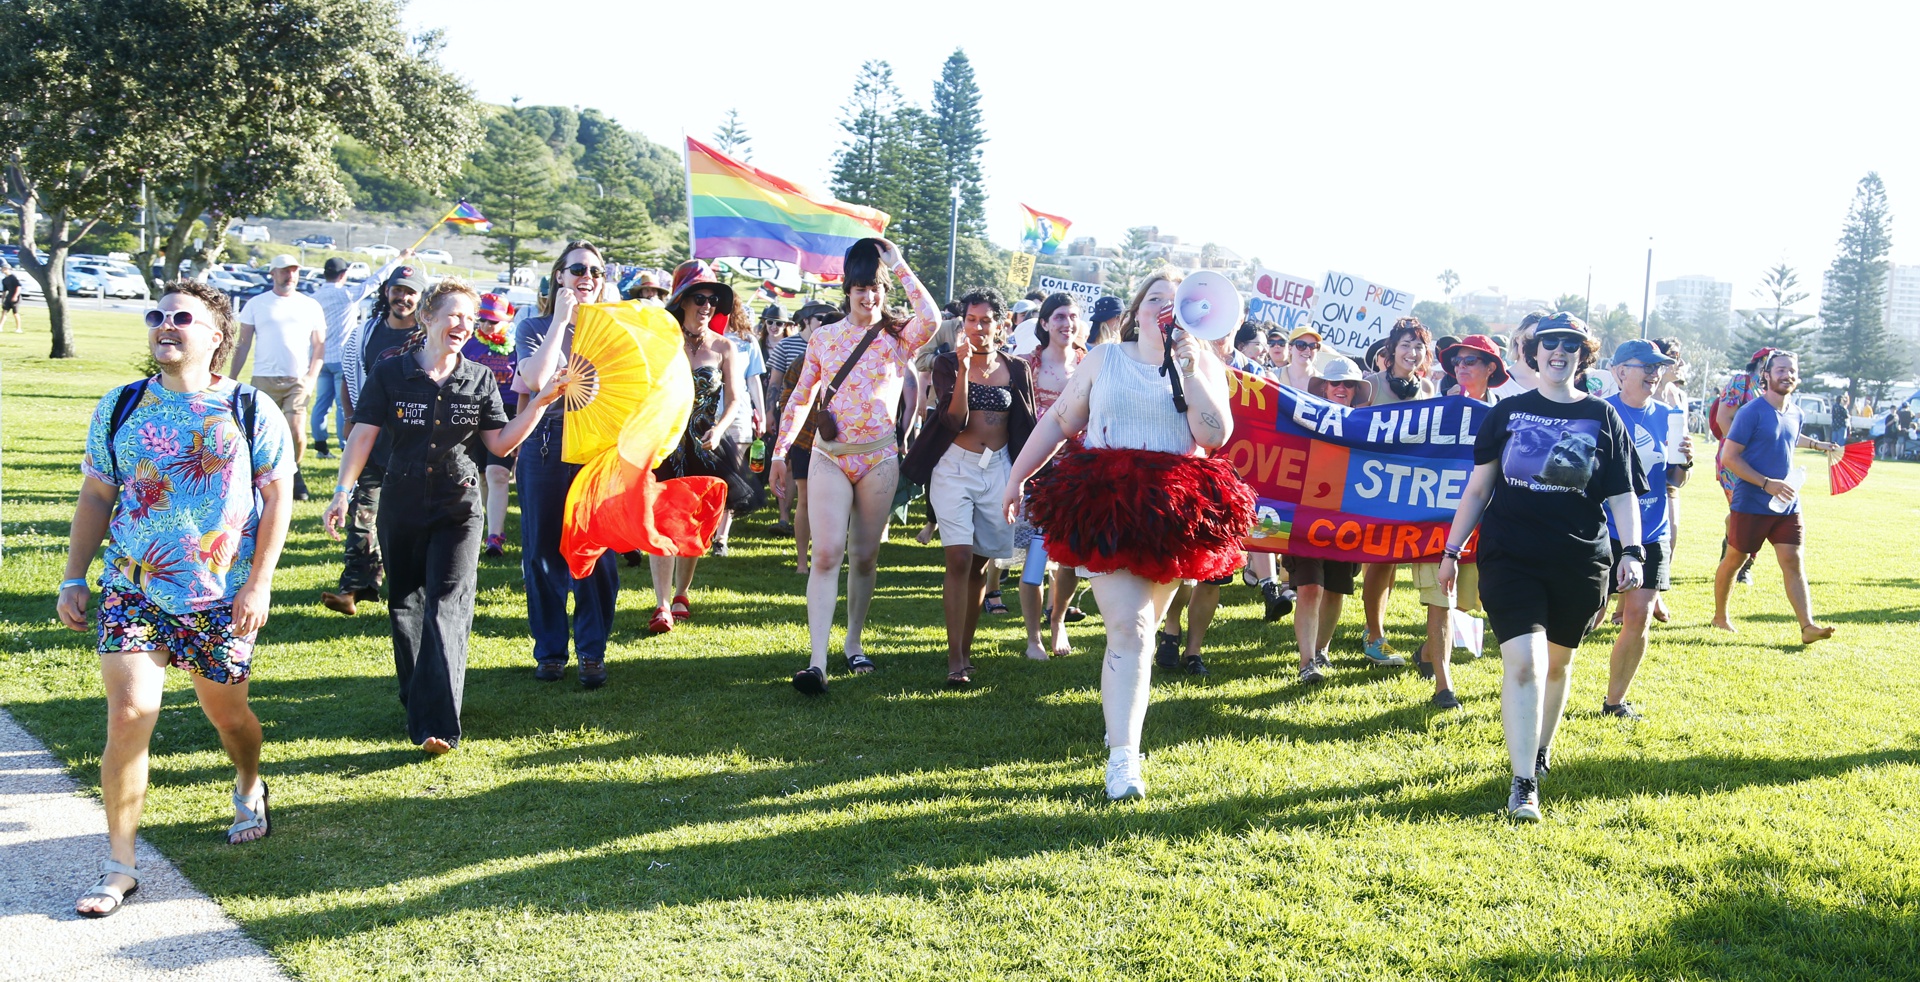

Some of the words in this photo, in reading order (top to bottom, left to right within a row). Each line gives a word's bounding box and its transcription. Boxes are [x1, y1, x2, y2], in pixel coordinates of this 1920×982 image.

[1041, 278, 1069, 291] COAL
[1071, 282, 1101, 295] ROTS
[1256, 273, 1314, 309] QUEER
[1323, 273, 1354, 297] NO
[1365, 284, 1407, 311] PRIDE
[1247, 296, 1309, 332] RISING
[1322, 302, 1354, 323] ON
[1368, 316, 1382, 334] A
[1311, 320, 1346, 346] DEAD
[1347, 330, 1376, 349] PLA
[1225, 370, 1266, 410] OR
[405, 407, 424, 418] HOT
[410, 418, 426, 426] HERE
[451, 414, 479, 426] COALS
[1509, 412, 1568, 426] existing??
[1354, 459, 1474, 510] STRE
[1510, 477, 1529, 488] THIS
